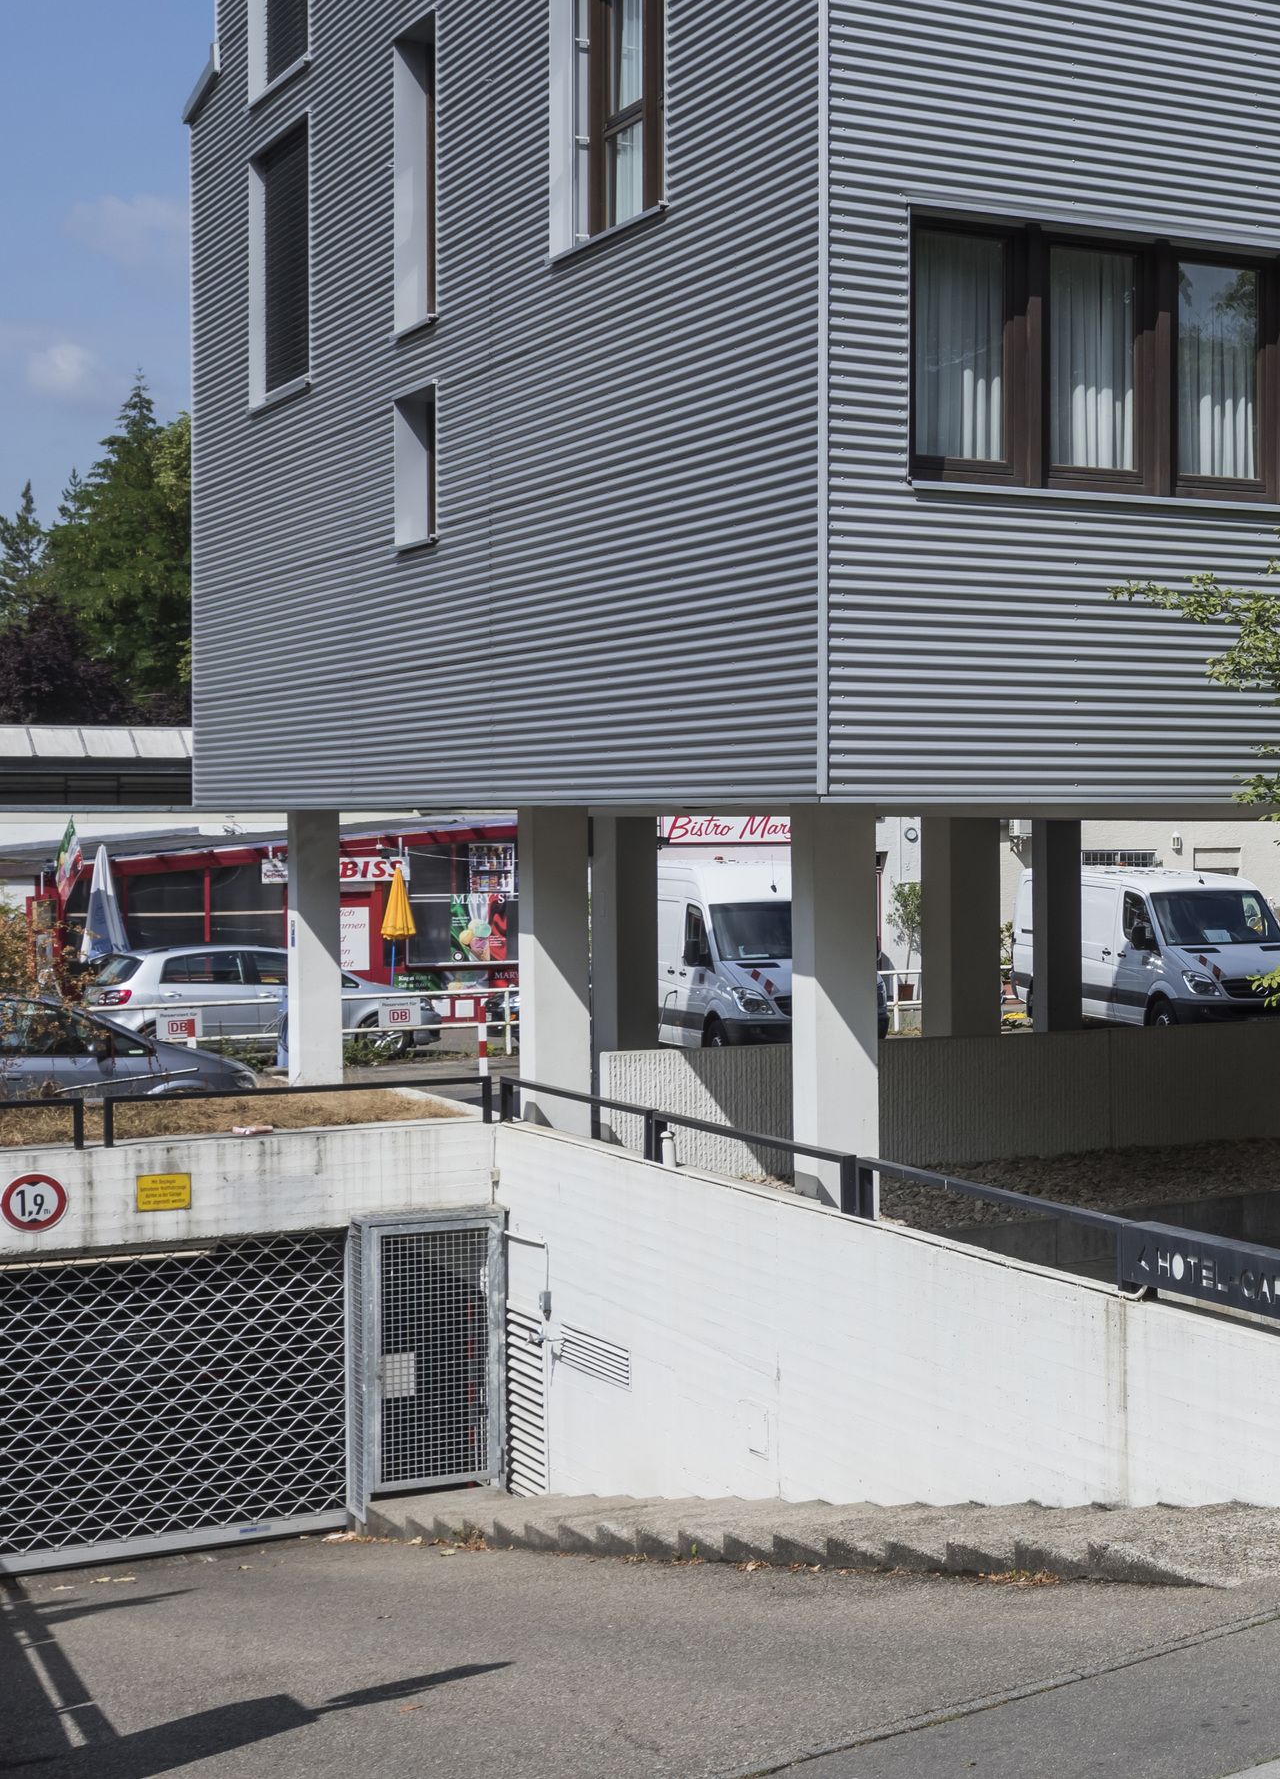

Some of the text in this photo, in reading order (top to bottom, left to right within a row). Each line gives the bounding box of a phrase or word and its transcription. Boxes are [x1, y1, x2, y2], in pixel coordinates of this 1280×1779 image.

[667, 816, 734, 840] Bistro
[392, 1011, 408, 1021] DB
[170, 1022, 188, 1033] DB
